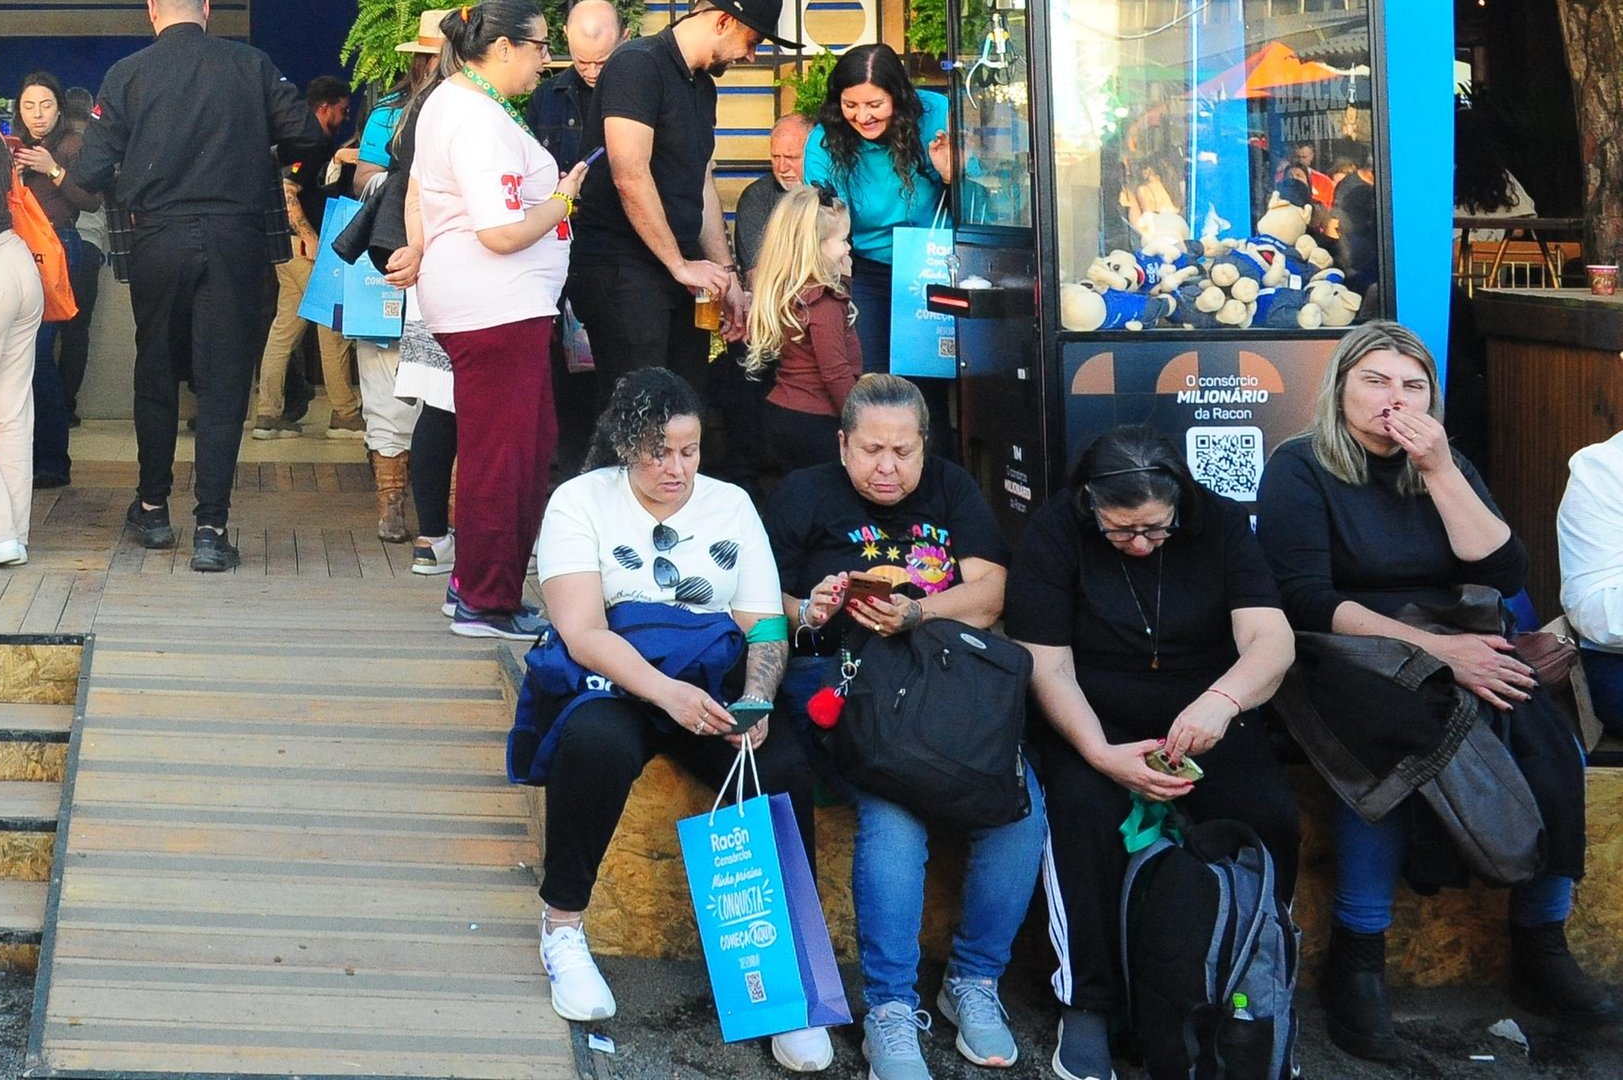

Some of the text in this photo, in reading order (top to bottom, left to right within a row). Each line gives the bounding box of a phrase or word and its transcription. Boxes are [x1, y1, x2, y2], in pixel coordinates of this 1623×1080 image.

[1186, 374, 1259, 387] O consórcio
[1176, 387, 1269, 404] MILIONÁRIO
[1194, 407, 1253, 420] da Racon
[718, 885, 764, 921] CONQUISTA
